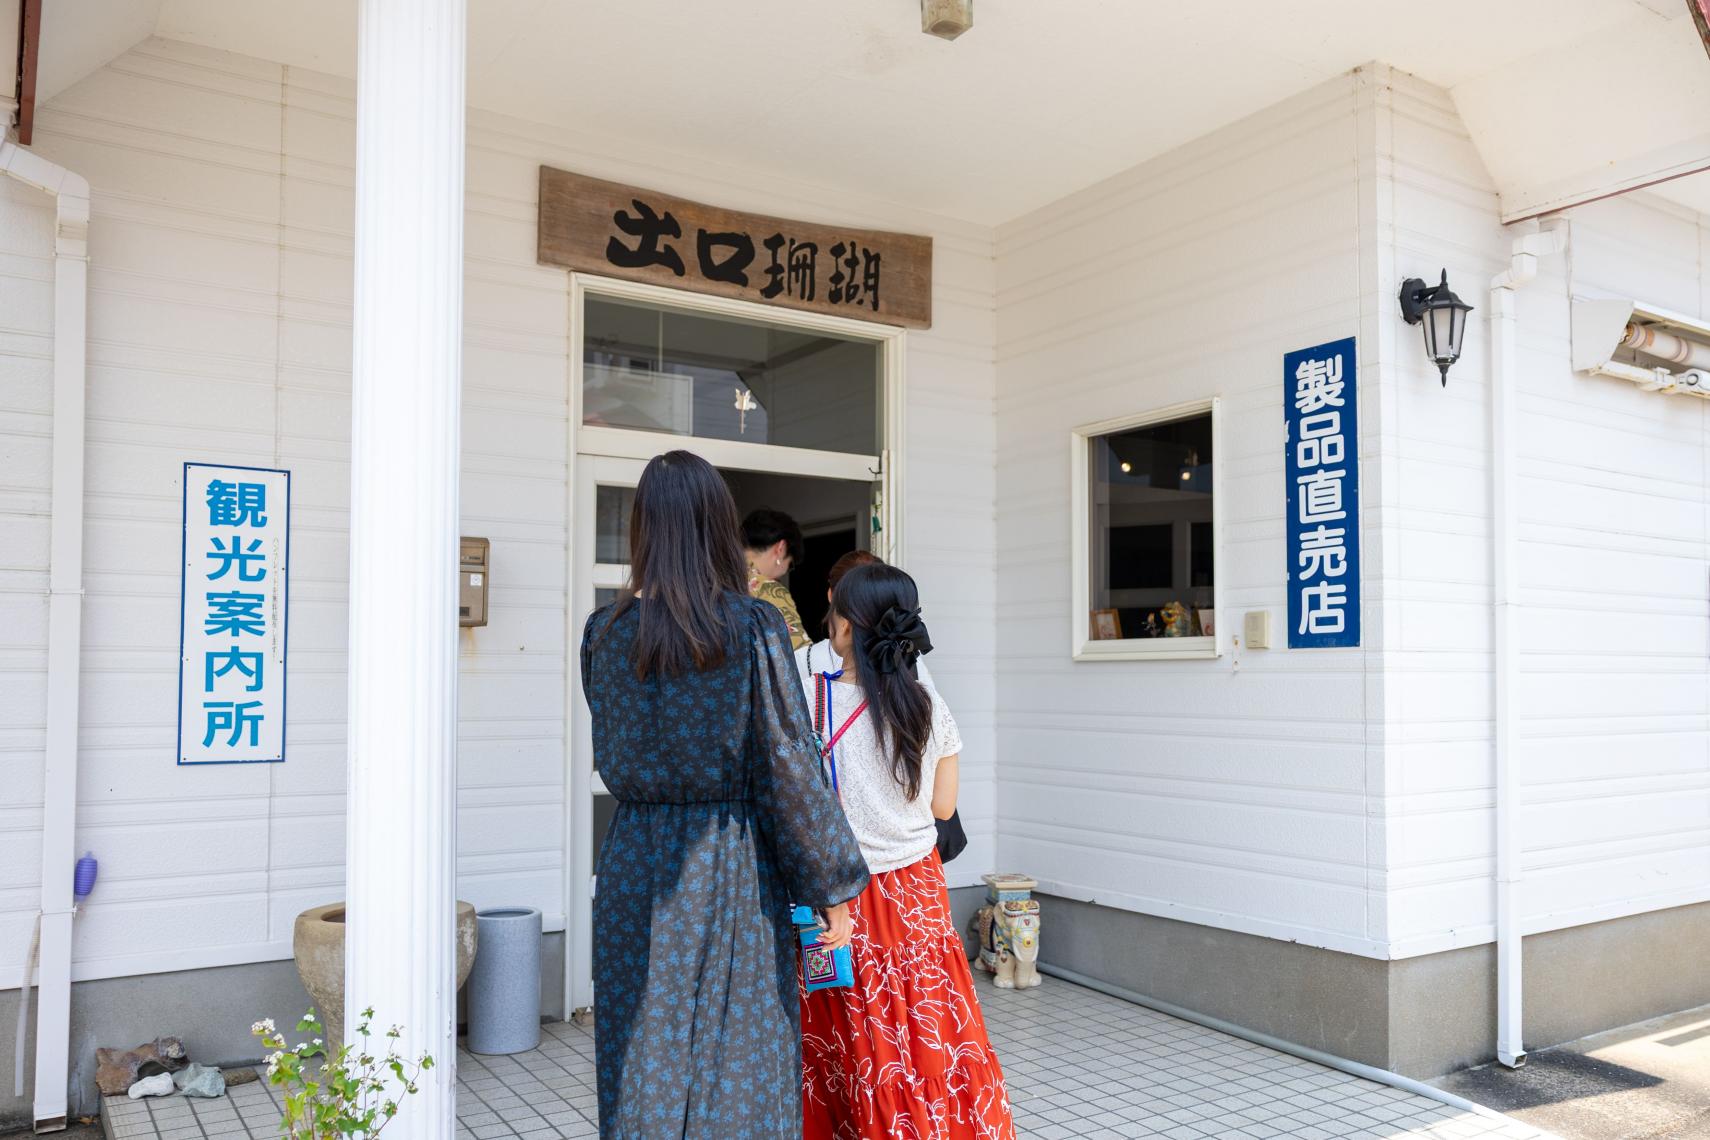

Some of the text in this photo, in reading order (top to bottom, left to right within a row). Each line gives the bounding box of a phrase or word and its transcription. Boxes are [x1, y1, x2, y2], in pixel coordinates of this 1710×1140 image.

[606, 199, 880, 311] 出口珊瑚
[203, 479, 267, 748] 観光案内所
[1295, 354, 1347, 635] 製品直売店
